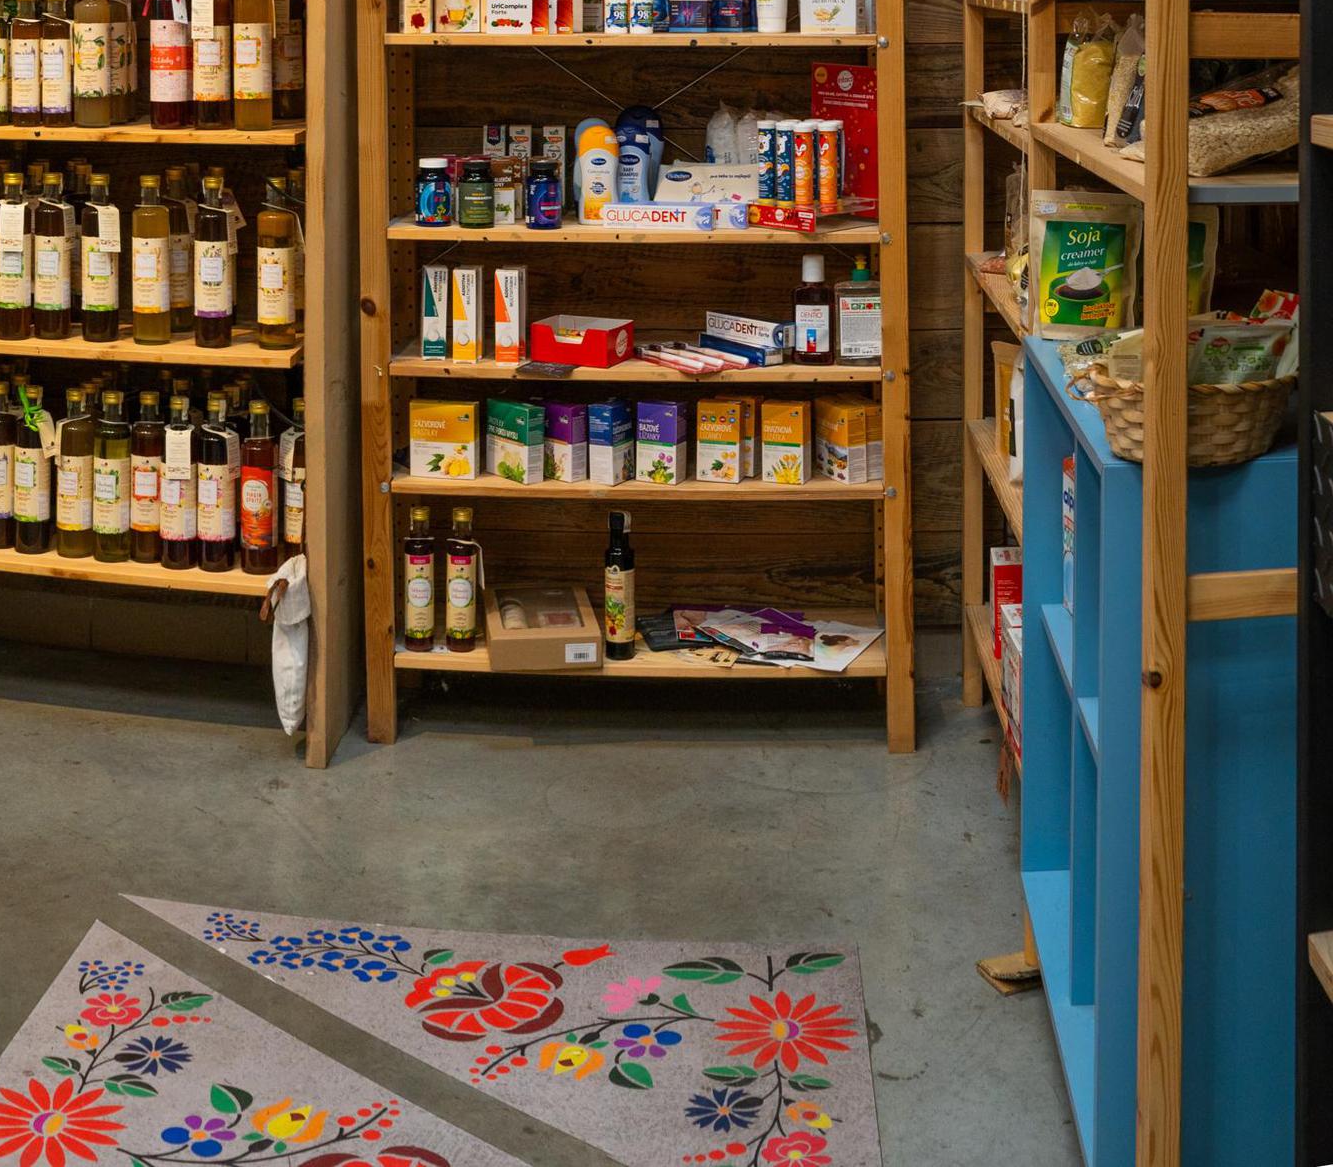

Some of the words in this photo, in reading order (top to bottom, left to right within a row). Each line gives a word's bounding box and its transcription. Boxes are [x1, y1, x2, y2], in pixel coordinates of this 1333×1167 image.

[491, 3, 528, 11] UriComplex
[613, 10, 625, 20] 98
[637, 10, 649, 20] 98
[1067, 226, 1101, 248] Soja
[1061, 247, 1106, 261] creamer
